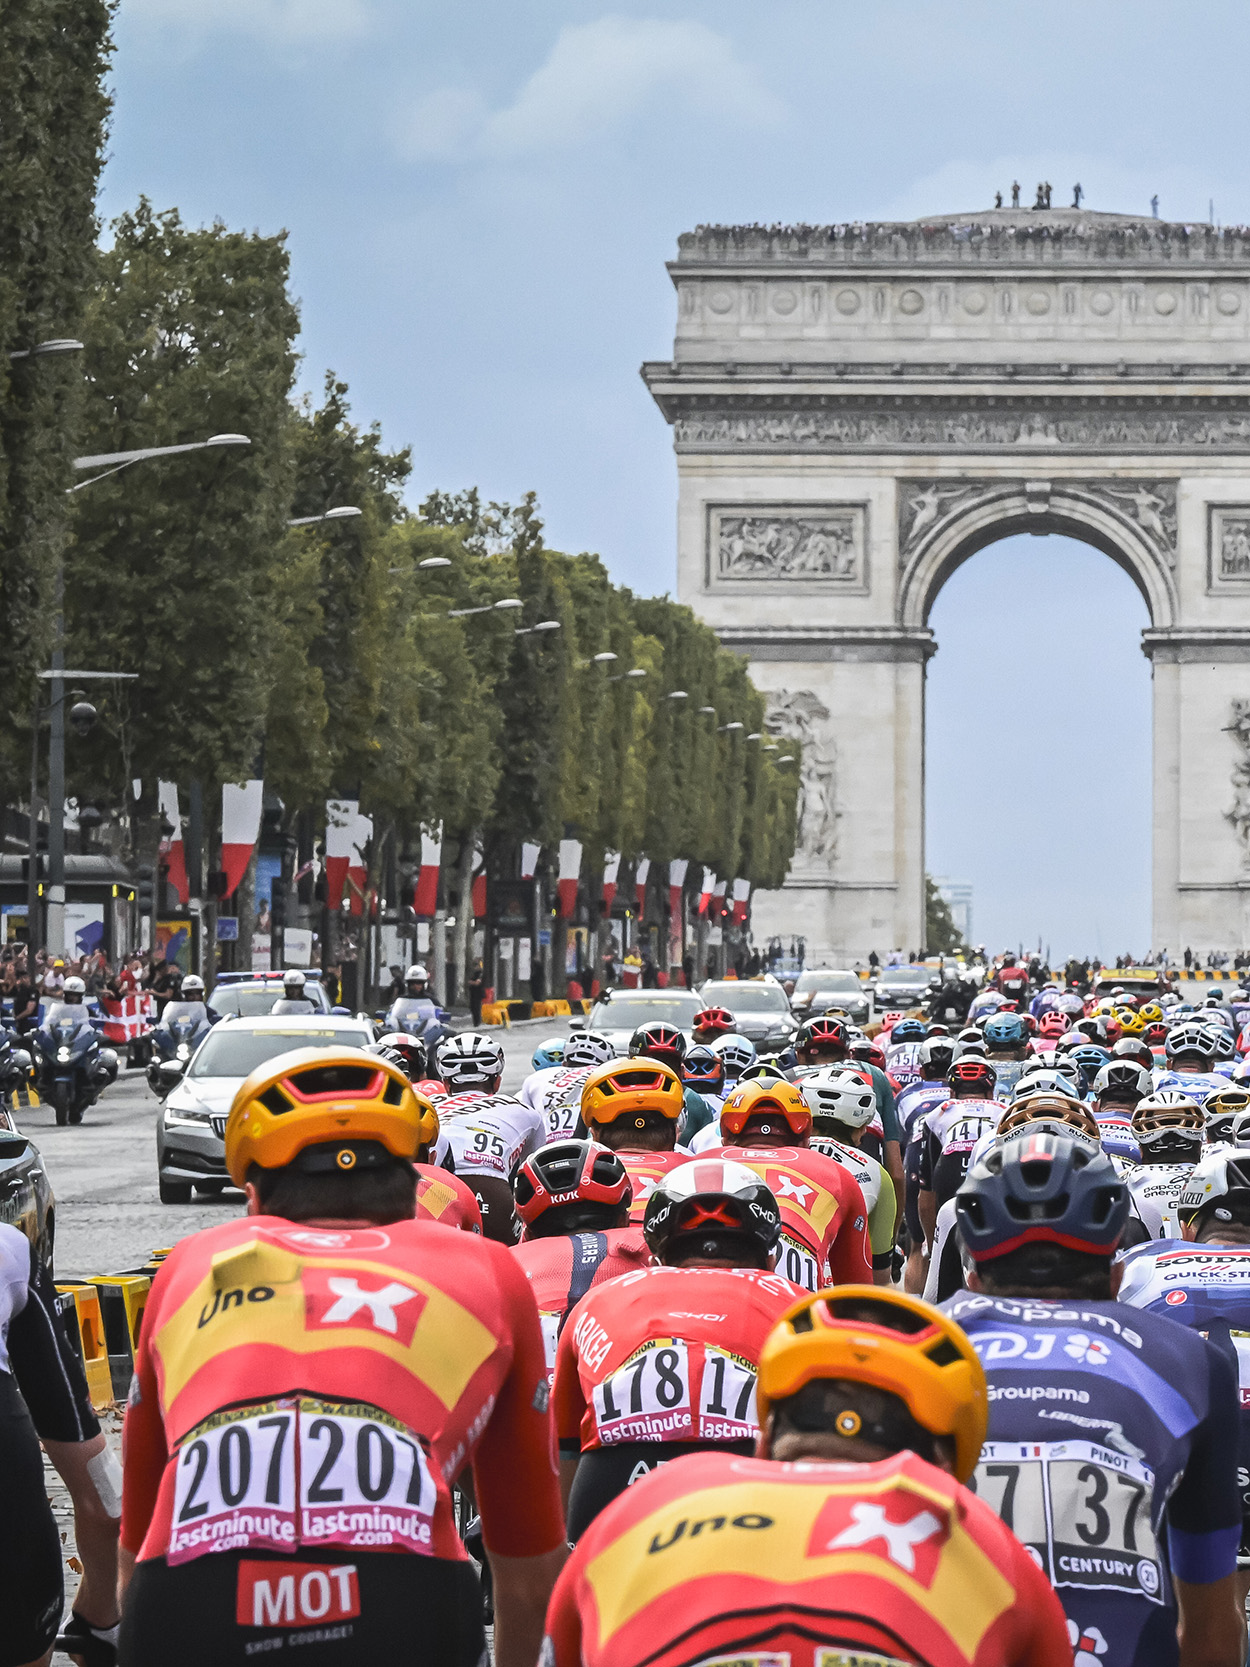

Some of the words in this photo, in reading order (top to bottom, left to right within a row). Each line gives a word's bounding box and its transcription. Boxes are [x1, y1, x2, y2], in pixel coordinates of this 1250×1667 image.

[549, 1108, 574, 1132] 92
[951, 1121, 970, 1142] 14
[1003, 1126, 1027, 1143] RUDY
[473, 1132, 504, 1158] 95
[1068, 1128, 1092, 1144] RUDY
[946, 1296, 1143, 1350] roupama
[601, 1349, 684, 1422] 178
[986, 1384, 1091, 1404] Groupama
[600, 1411, 693, 1442] lastminute
[178, 1415, 291, 1524] 207
[307, 1417, 424, 1507] 207
[1090, 1447, 1129, 1471] PINOT
[966, 1465, 1020, 1534] 7
[1075, 1465, 1146, 1552] 37
[169, 1510, 296, 1554] lastminute
[302, 1507, 431, 1545] lastminute
[350, 1531, 394, 1546] .com
[209, 1532, 250, 1553] .com
[1058, 1556, 1135, 1577] CENTURY
[253, 1564, 357, 1627] MOT
[245, 1637, 284, 1656] SHOW
[288, 1624, 354, 1647] COURAGE!
